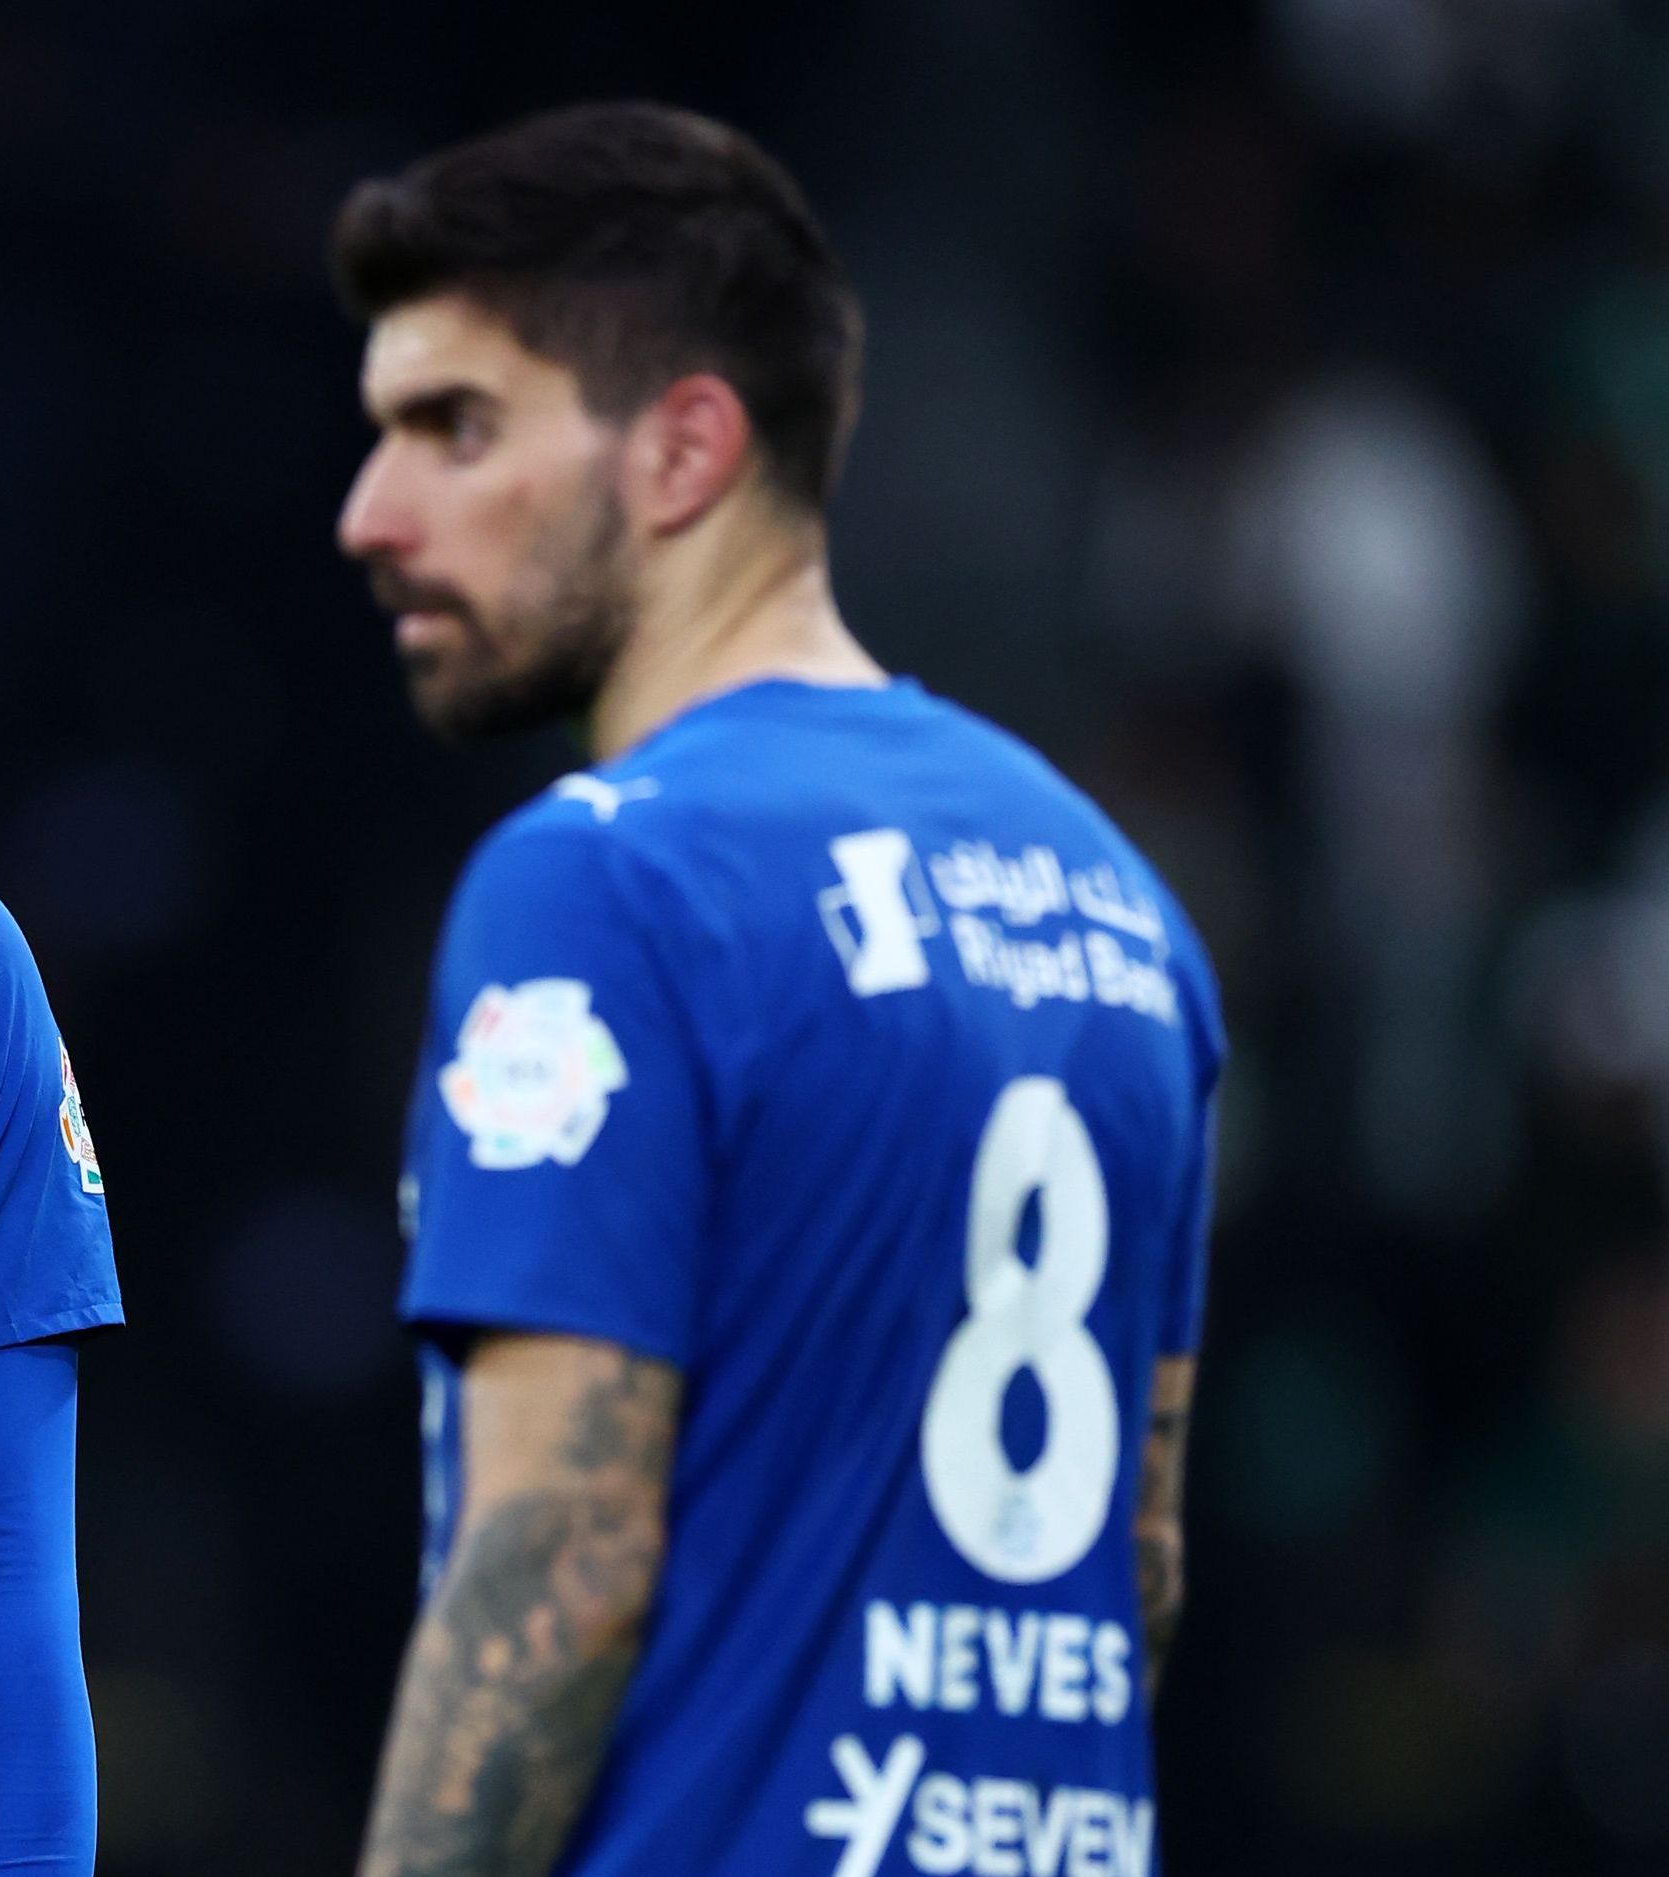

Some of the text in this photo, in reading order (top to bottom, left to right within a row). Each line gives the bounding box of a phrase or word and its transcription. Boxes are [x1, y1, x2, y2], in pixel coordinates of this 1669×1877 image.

[920, 1073, 1120, 1585] 8
[864, 1597, 1132, 1728] NEVES
[906, 1770, 1158, 1877] SEVEN
